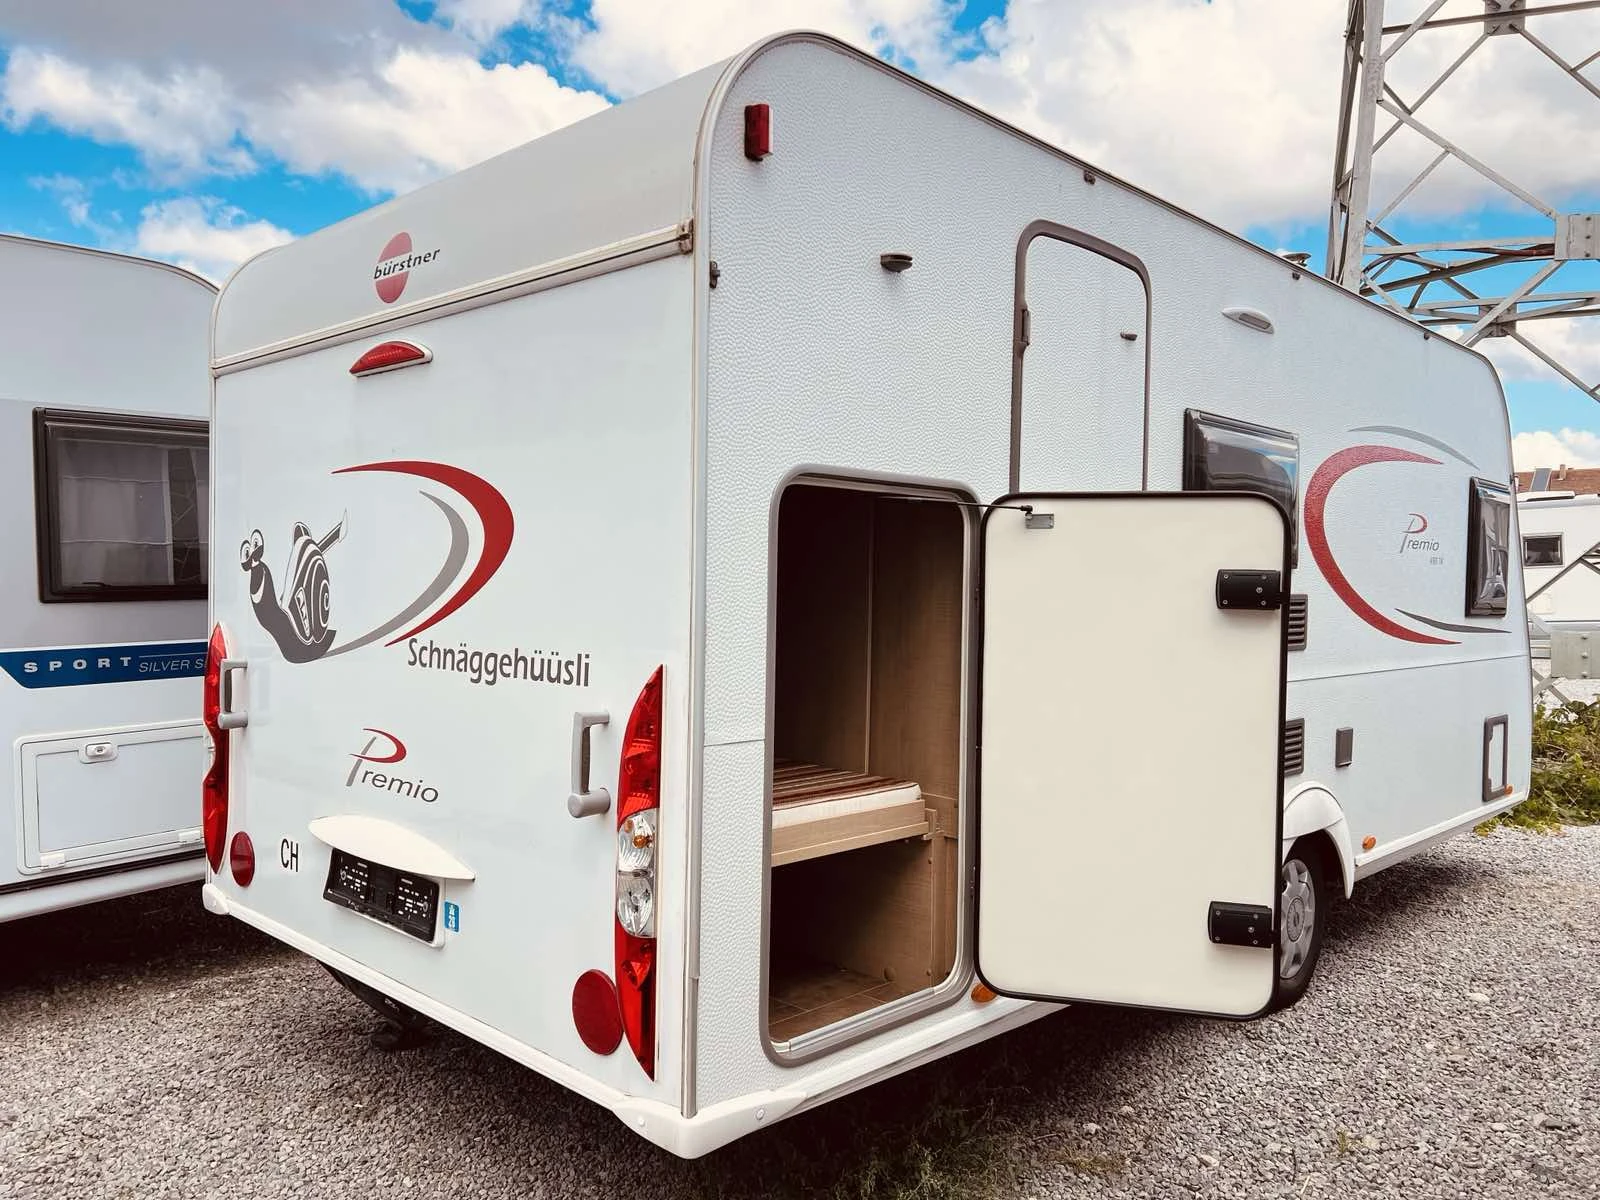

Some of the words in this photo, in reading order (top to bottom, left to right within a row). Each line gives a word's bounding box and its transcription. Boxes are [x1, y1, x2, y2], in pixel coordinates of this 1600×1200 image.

[374, 248, 441, 280] bürstner
[1400, 513, 1440, 554] Premio
[23, 656, 132, 673] SPORT
[138, 659, 190, 673] SILVER
[407, 637, 591, 687] Schnäggehüüsli
[346, 728, 439, 803] Premio
[280, 838, 299, 873] CH
